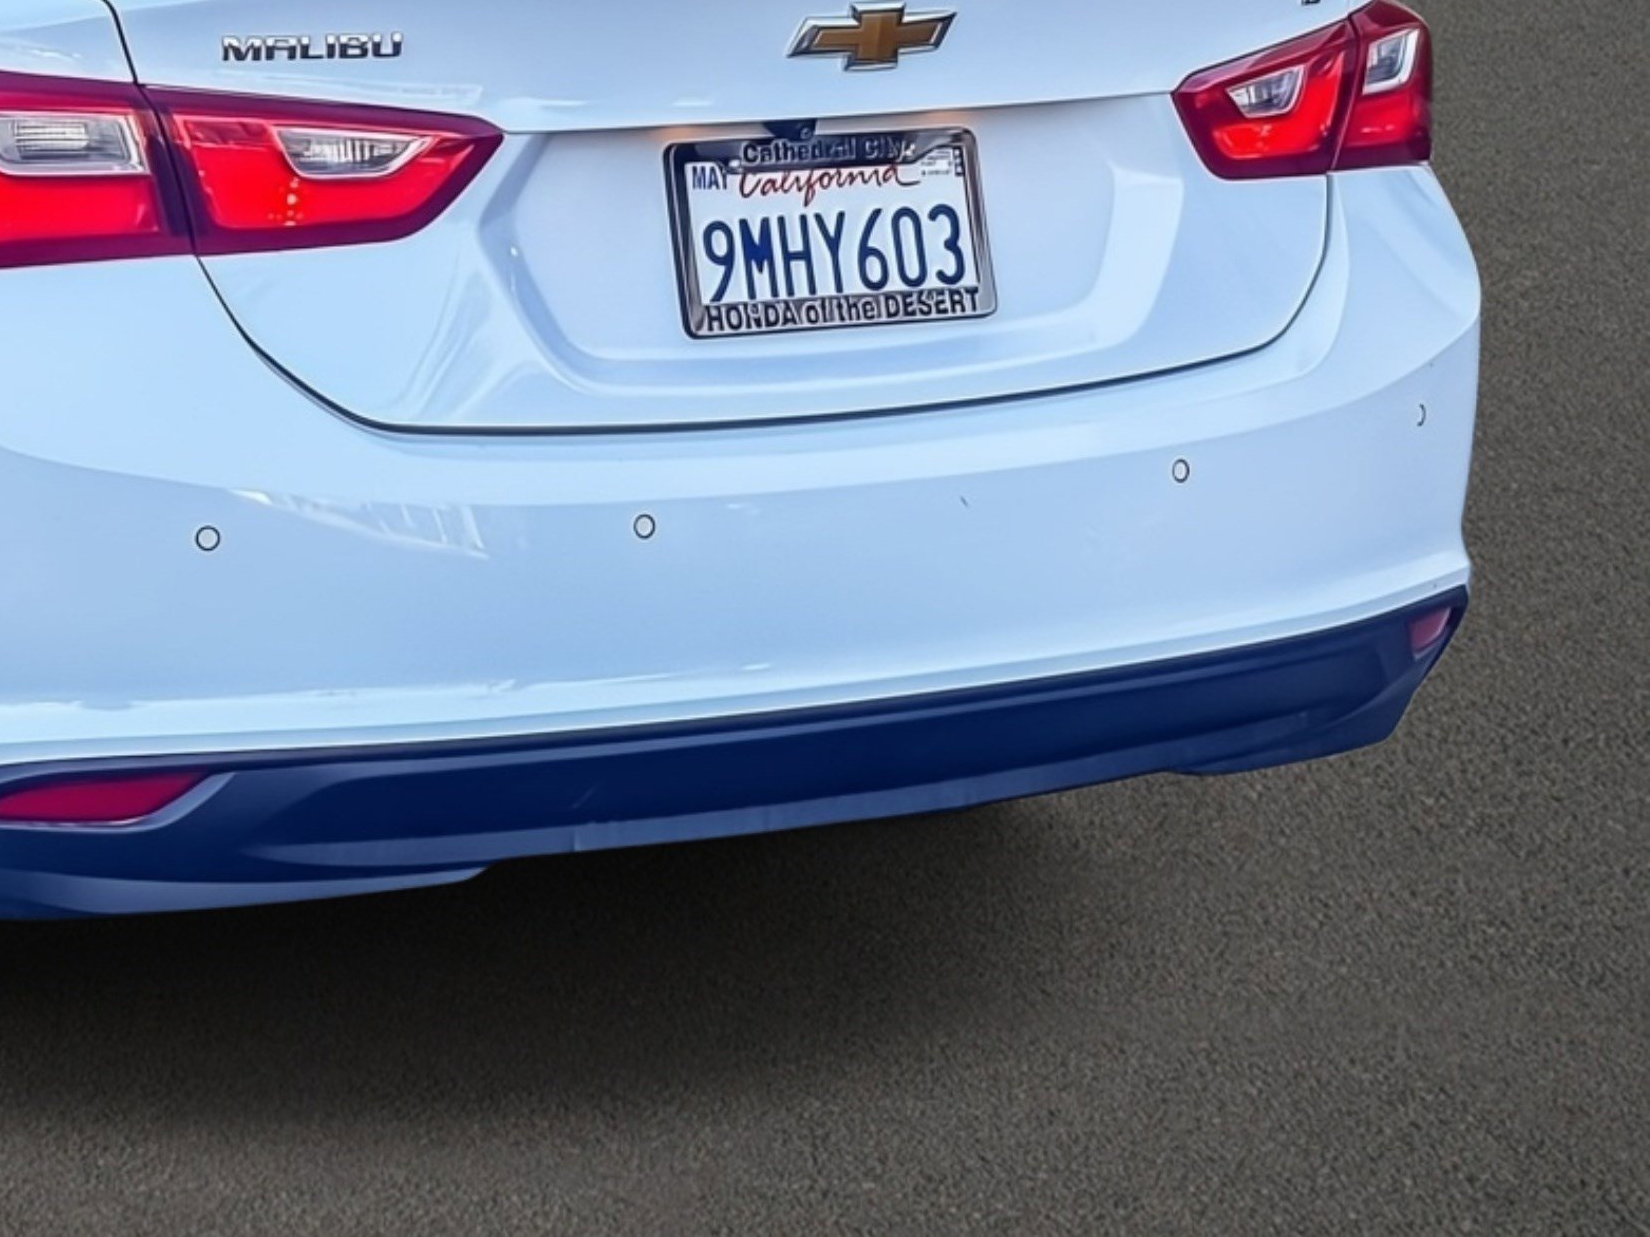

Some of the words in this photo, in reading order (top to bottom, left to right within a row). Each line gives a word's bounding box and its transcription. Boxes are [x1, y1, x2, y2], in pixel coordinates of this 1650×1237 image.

[222, 30, 404, 62] MALIBU
[742, 137, 856, 165] Cathedral
[691, 164, 730, 191] MAY
[739, 163, 921, 207] California
[702, 202, 966, 303] 9MHY603
[705, 303, 799, 332] HONDA
[802, 301, 829, 326] of
[835, 296, 879, 321] the
[885, 288, 980, 319] DESERT
